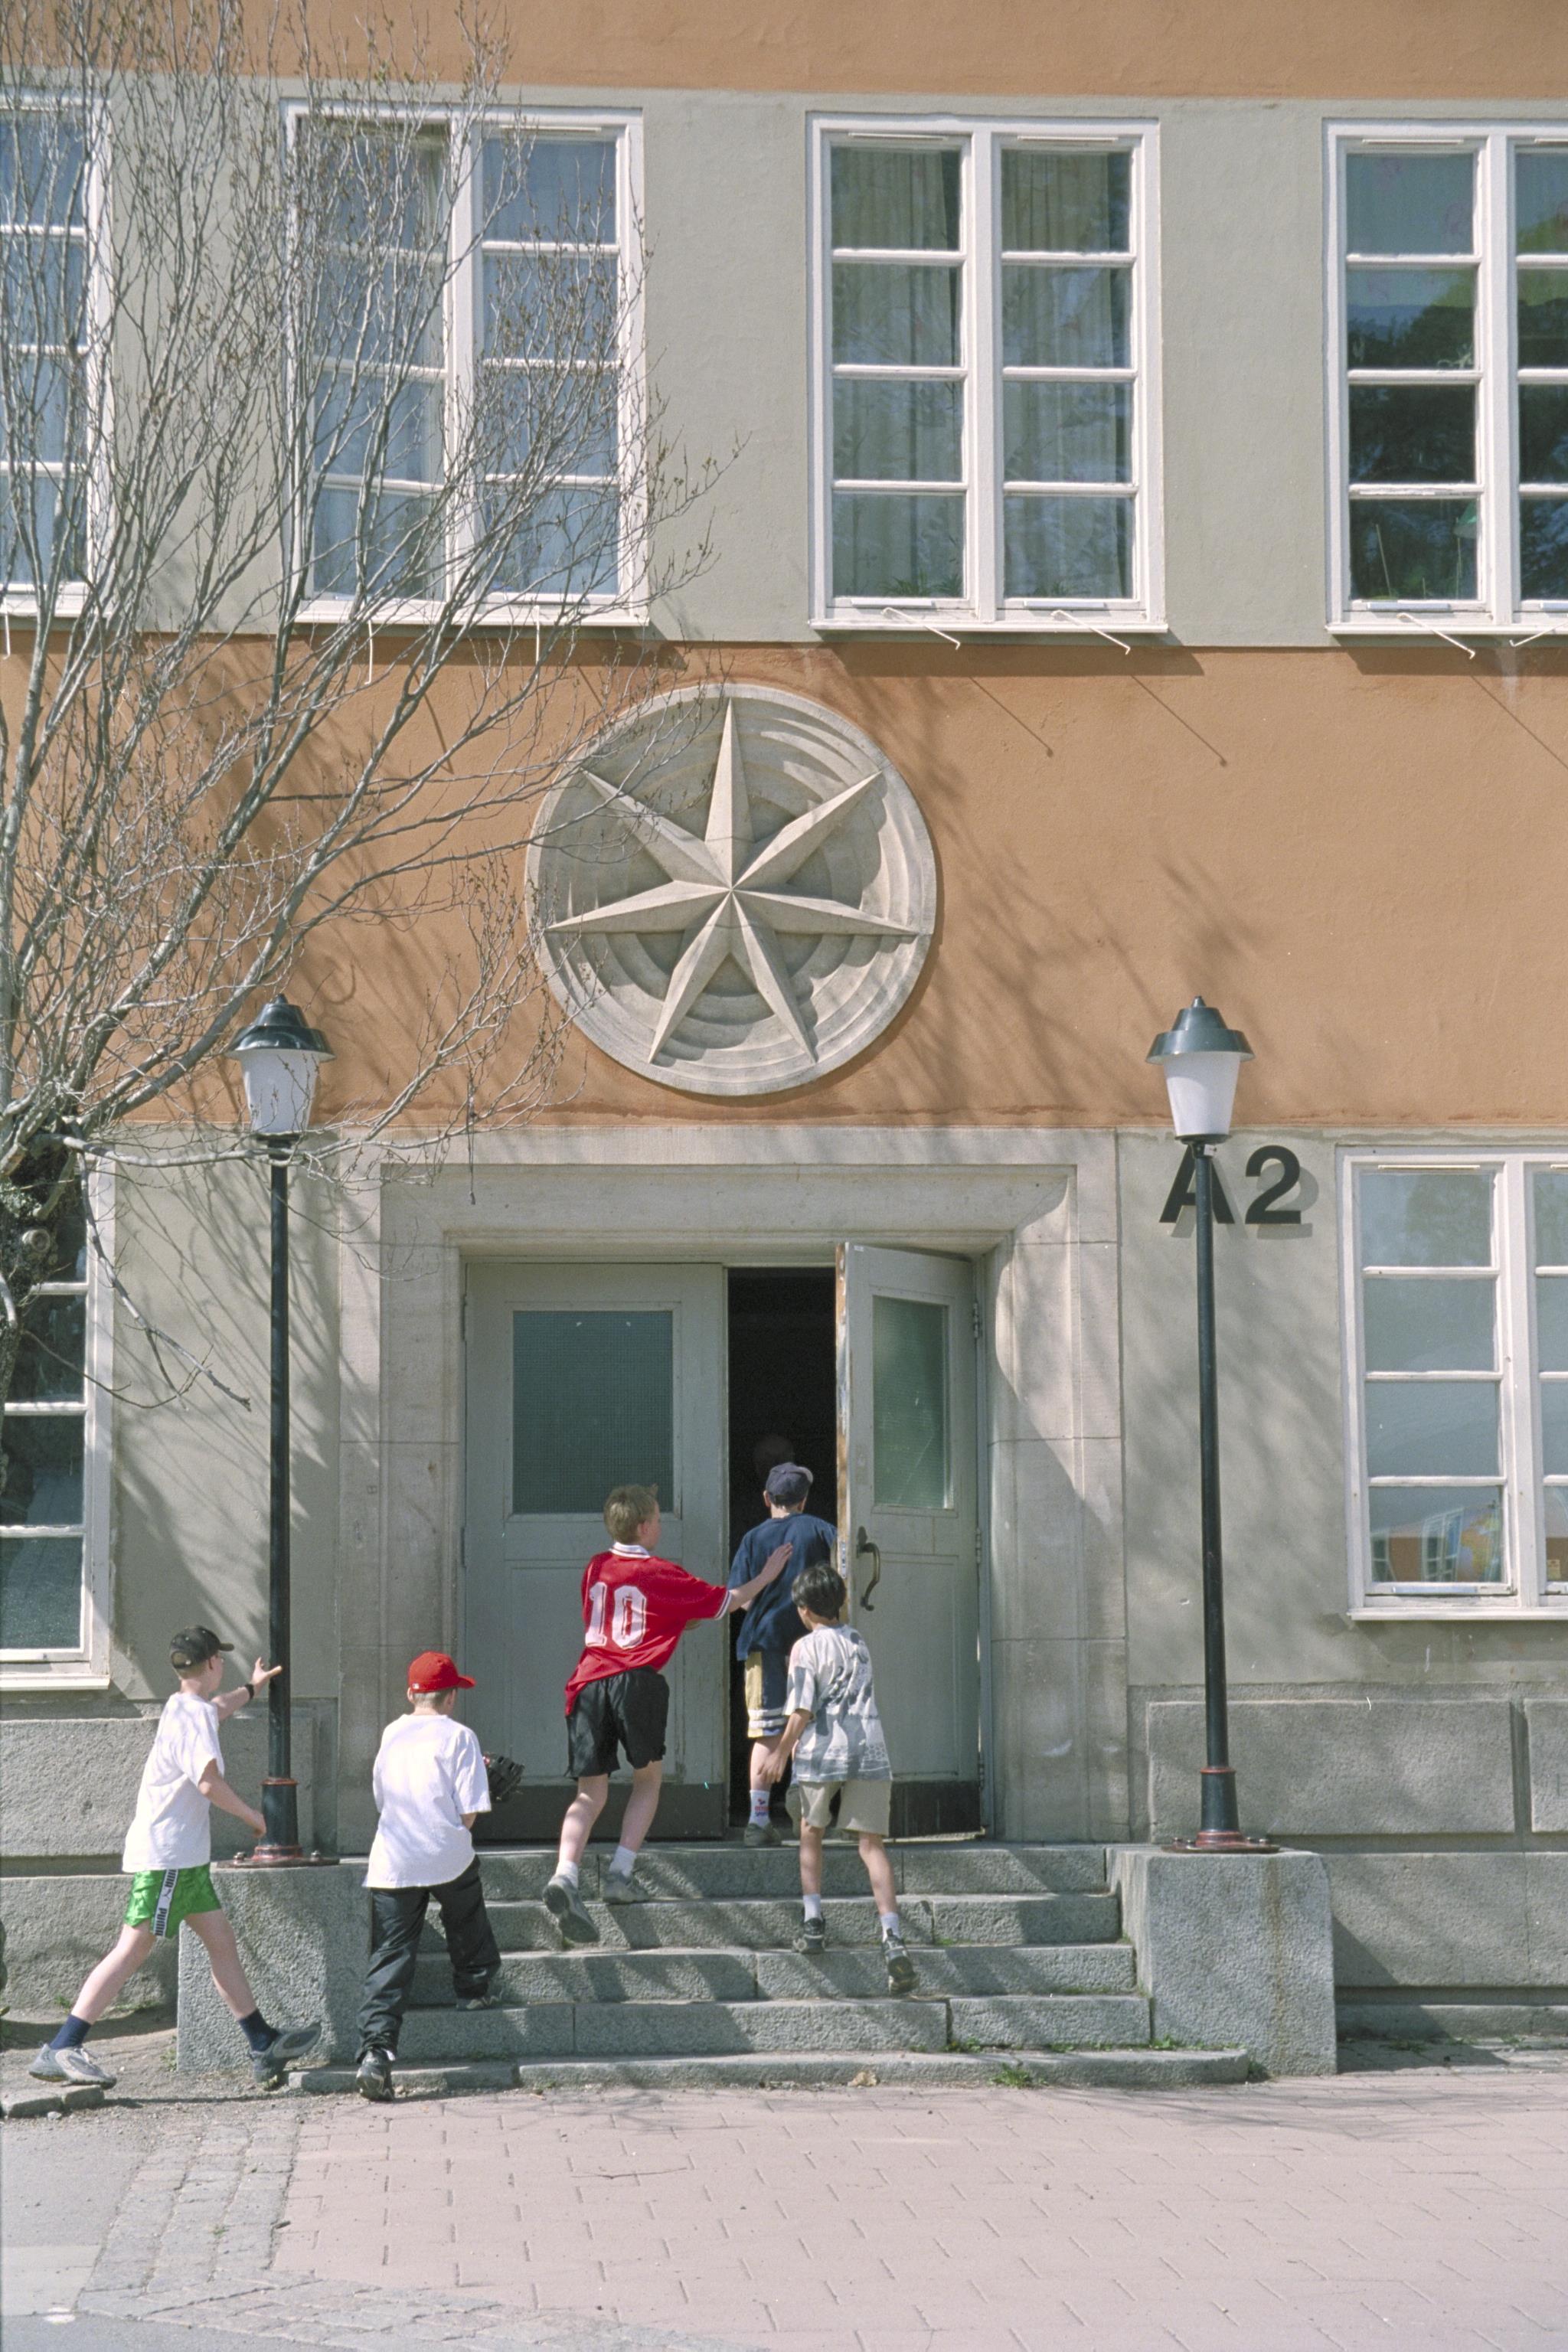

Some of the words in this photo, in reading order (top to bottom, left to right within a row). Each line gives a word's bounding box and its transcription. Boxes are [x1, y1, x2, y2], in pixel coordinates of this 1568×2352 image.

[1159, 1145, 1301, 1224] A2
[585, 1582, 646, 1649] 10
[155, 1907, 167, 1936] PUMA
